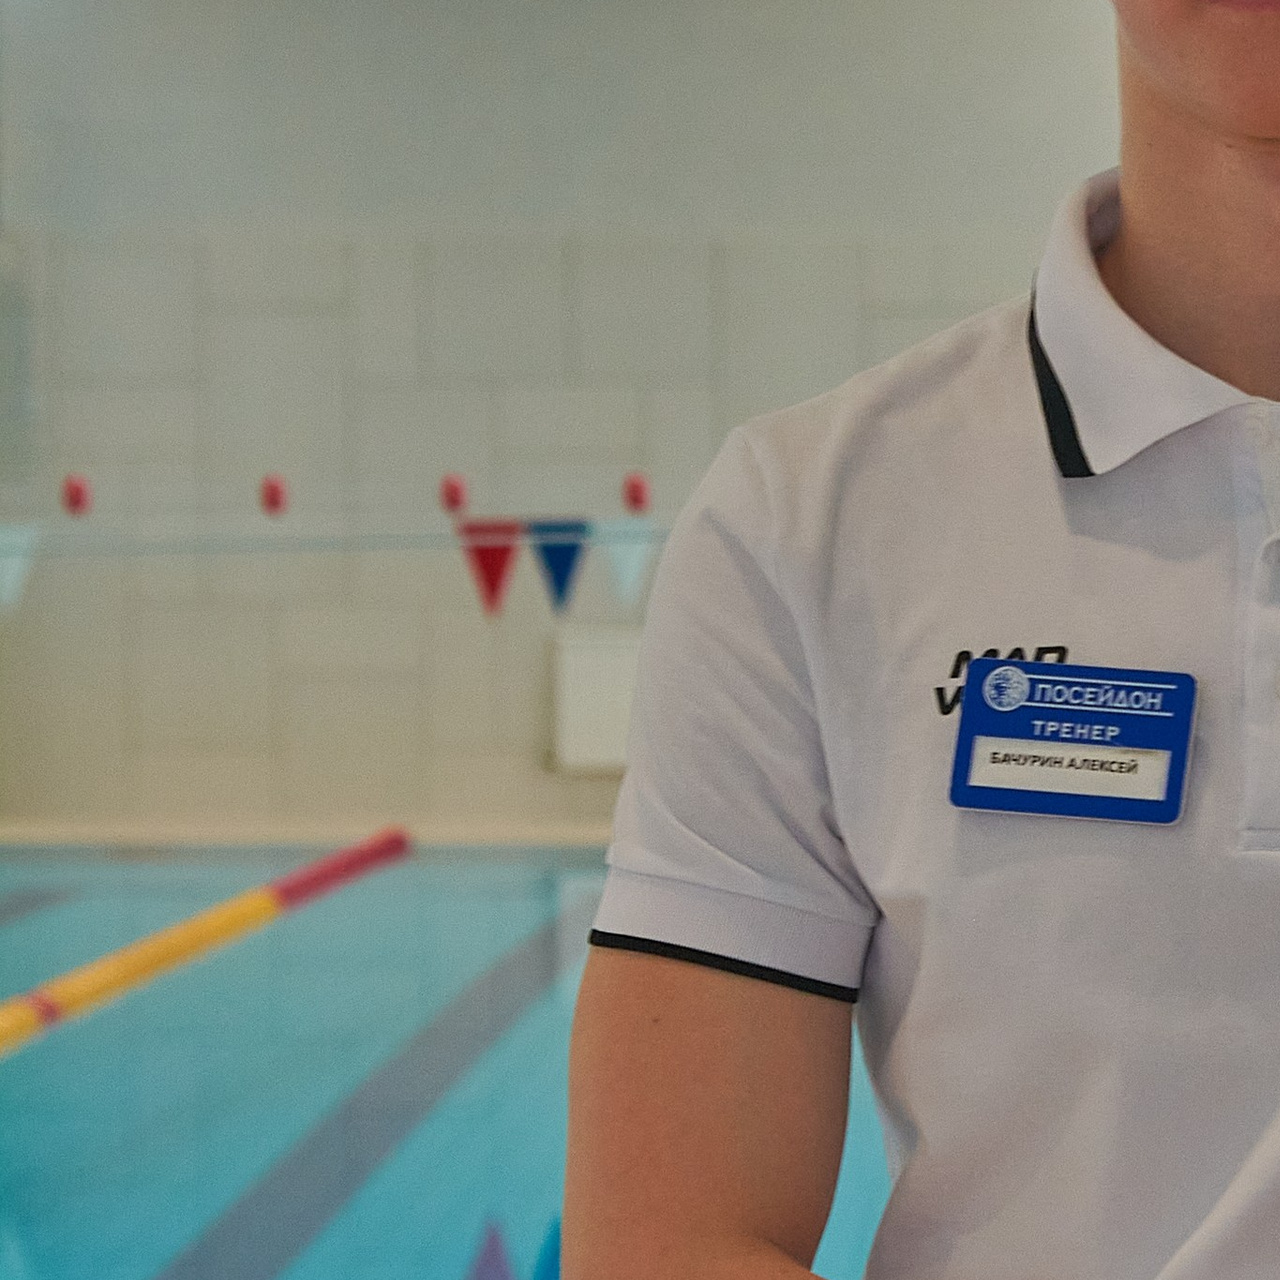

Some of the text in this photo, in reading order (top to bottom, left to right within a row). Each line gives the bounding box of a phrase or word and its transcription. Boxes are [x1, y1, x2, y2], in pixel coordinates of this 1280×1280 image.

[1034, 683, 1163, 710] ПОСЕЙДОН
[1031, 720, 1121, 741] ТРЕНЕР
[989, 751, 1138, 774] БАЧУРИН АЛЕКСЕЙ
